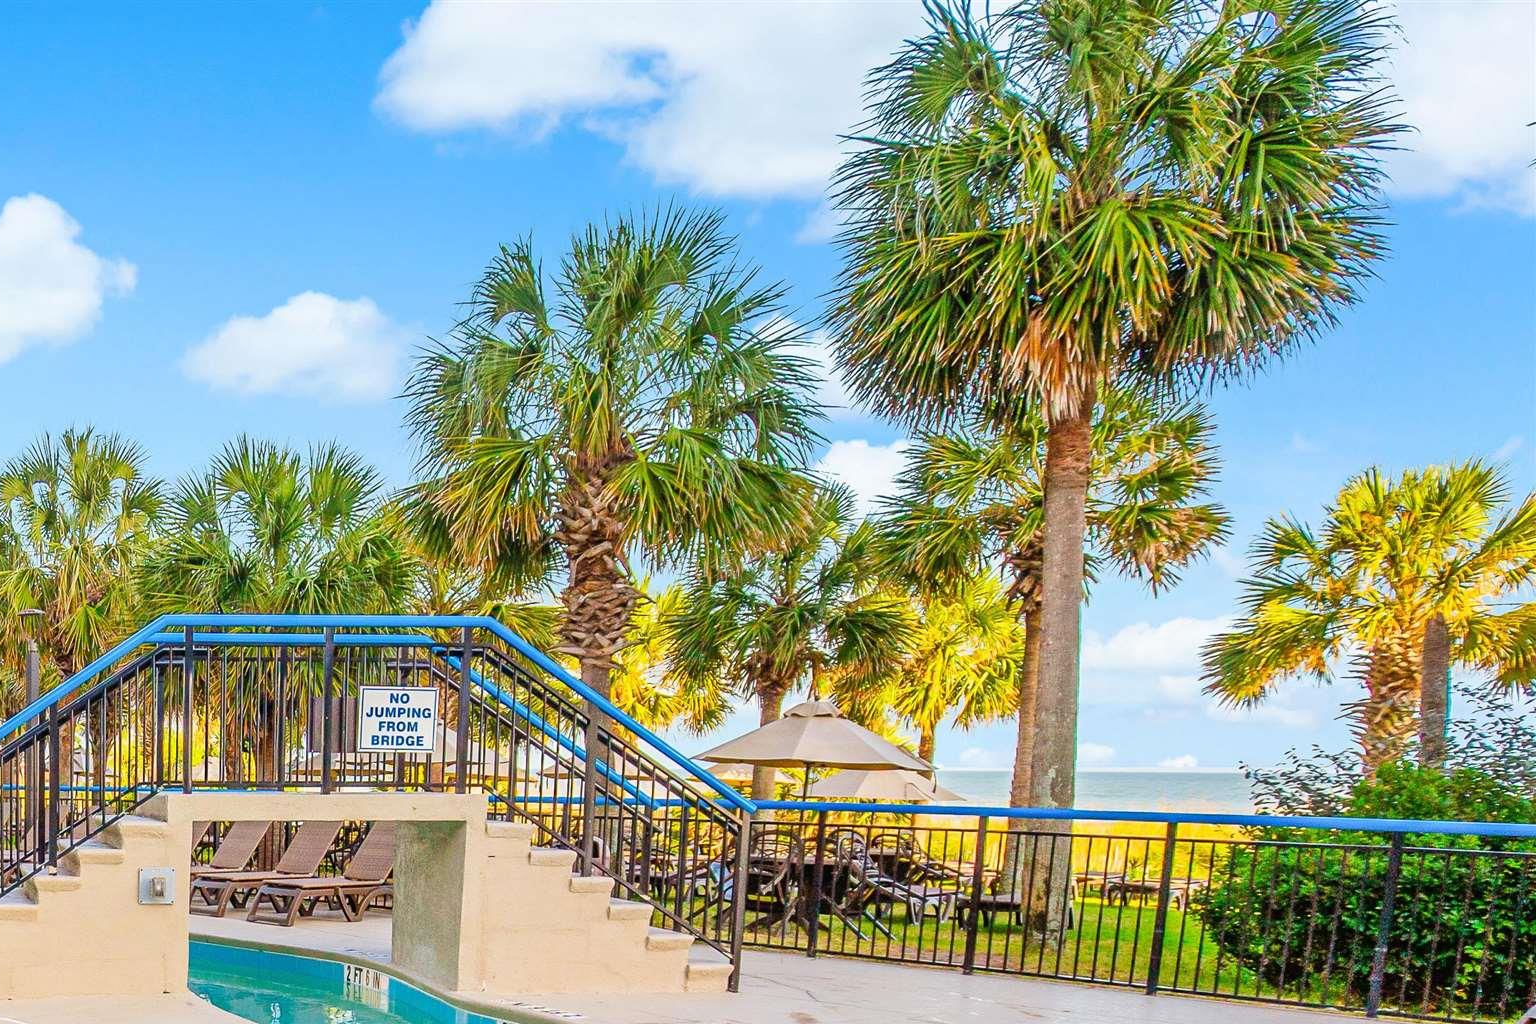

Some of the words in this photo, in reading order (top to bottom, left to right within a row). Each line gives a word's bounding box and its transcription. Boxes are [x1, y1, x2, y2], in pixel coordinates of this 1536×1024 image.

[390, 693, 410, 704] NO
[366, 707, 432, 719] JUMPING
[378, 721, 418, 732] FROM
[371, 735, 424, 747] BRIDGE
[346, 965, 352, 982] 2
[354, 967, 363, 984] FT
[366, 969, 370, 986] 6
[373, 971, 381, 990] IN
